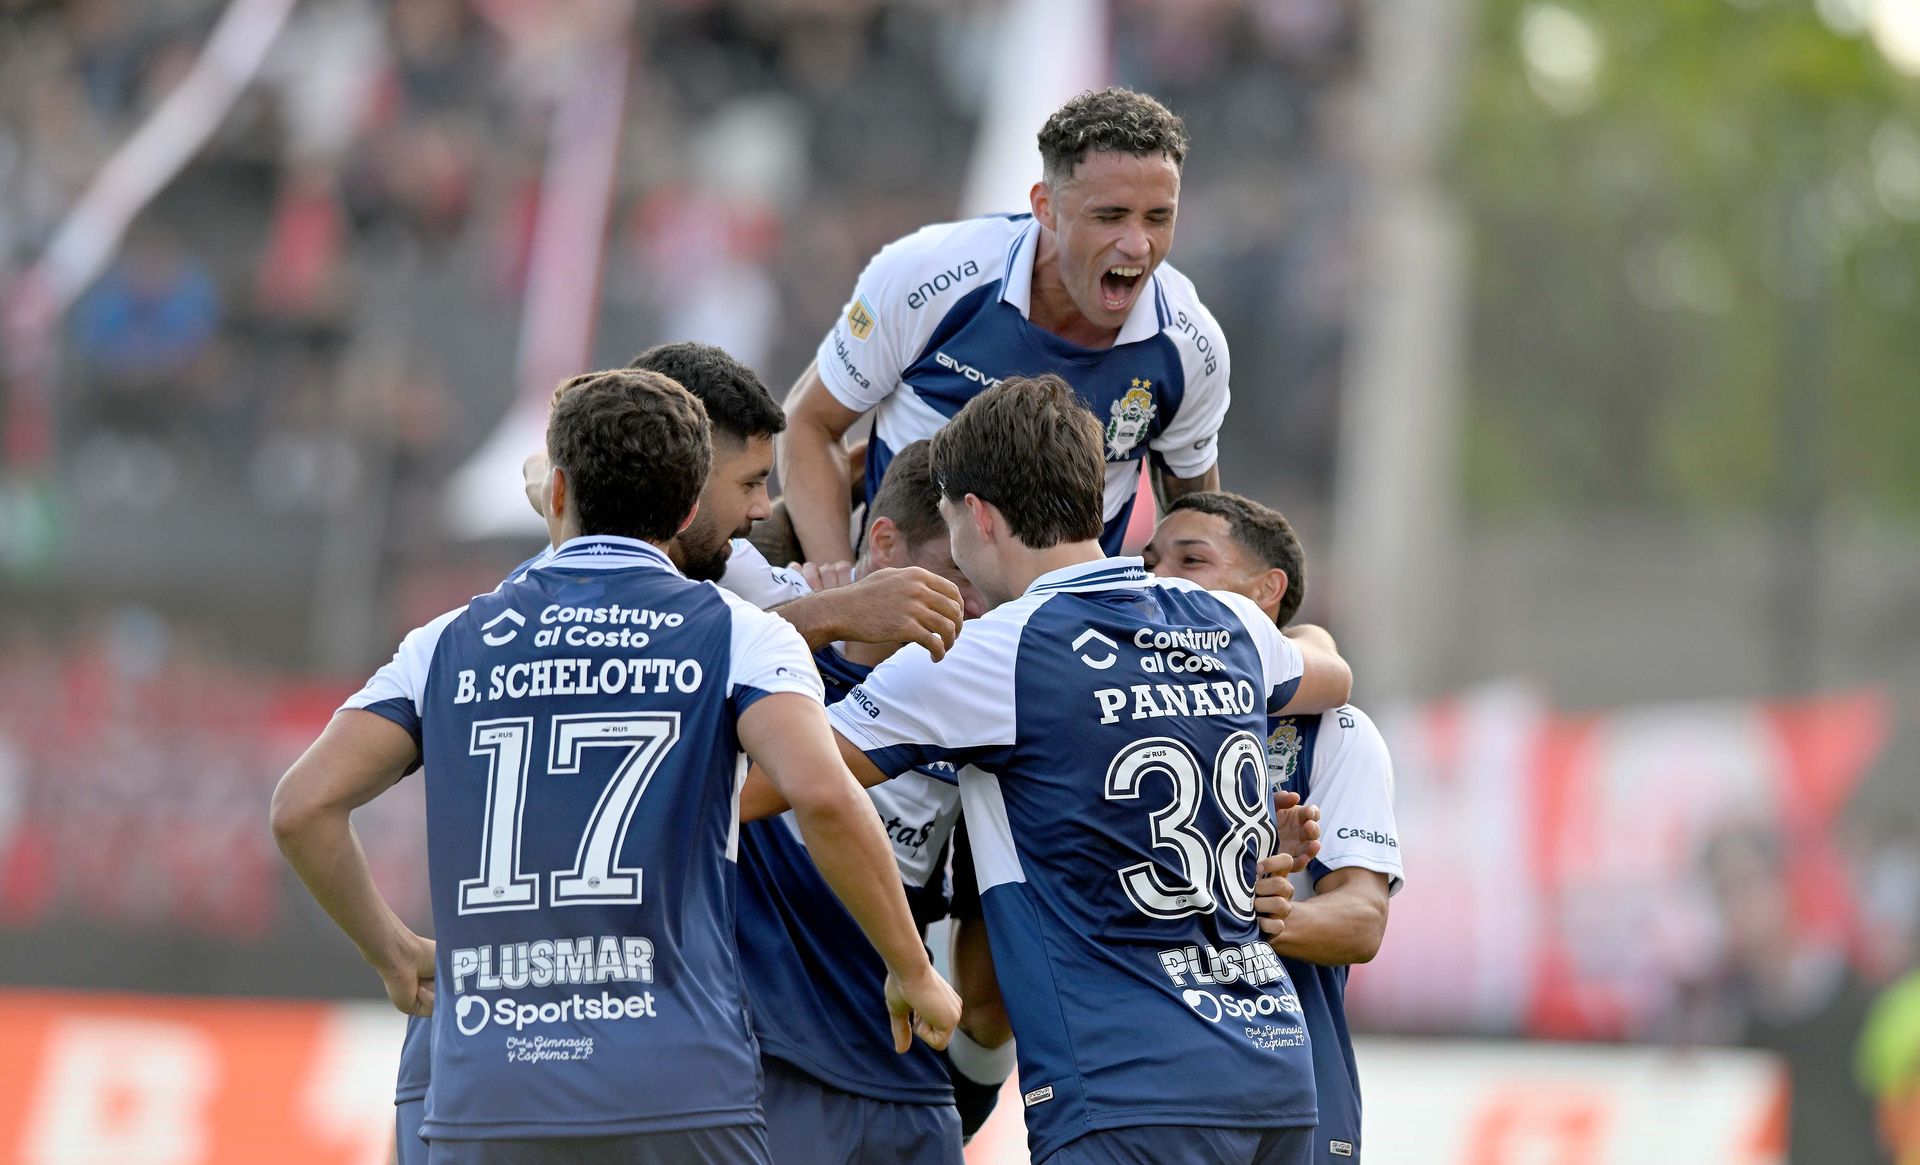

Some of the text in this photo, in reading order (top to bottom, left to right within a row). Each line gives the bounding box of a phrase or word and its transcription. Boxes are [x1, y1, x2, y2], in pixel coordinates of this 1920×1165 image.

[907, 259, 979, 310] enova
[1176, 311, 1217, 377] enova
[534, 625, 650, 648] al Costo
[540, 604, 684, 630] Construyo
[1133, 628, 1231, 653] Construyo
[453, 658, 703, 704] B. SCHELOTTO
[1140, 651, 1165, 673] al
[1094, 679, 1255, 725] PANARO
[458, 711, 681, 916] 17
[1105, 730, 1277, 922] 38
[1336, 827, 1398, 848] Casabla
[452, 936, 654, 995] PLUSMAR
[493, 991, 657, 1031] Sportsbet
[507, 1050, 516, 1063] y
[517, 1047, 569, 1064] Esgrima
[534, 1035, 594, 1052] Gimnasia
